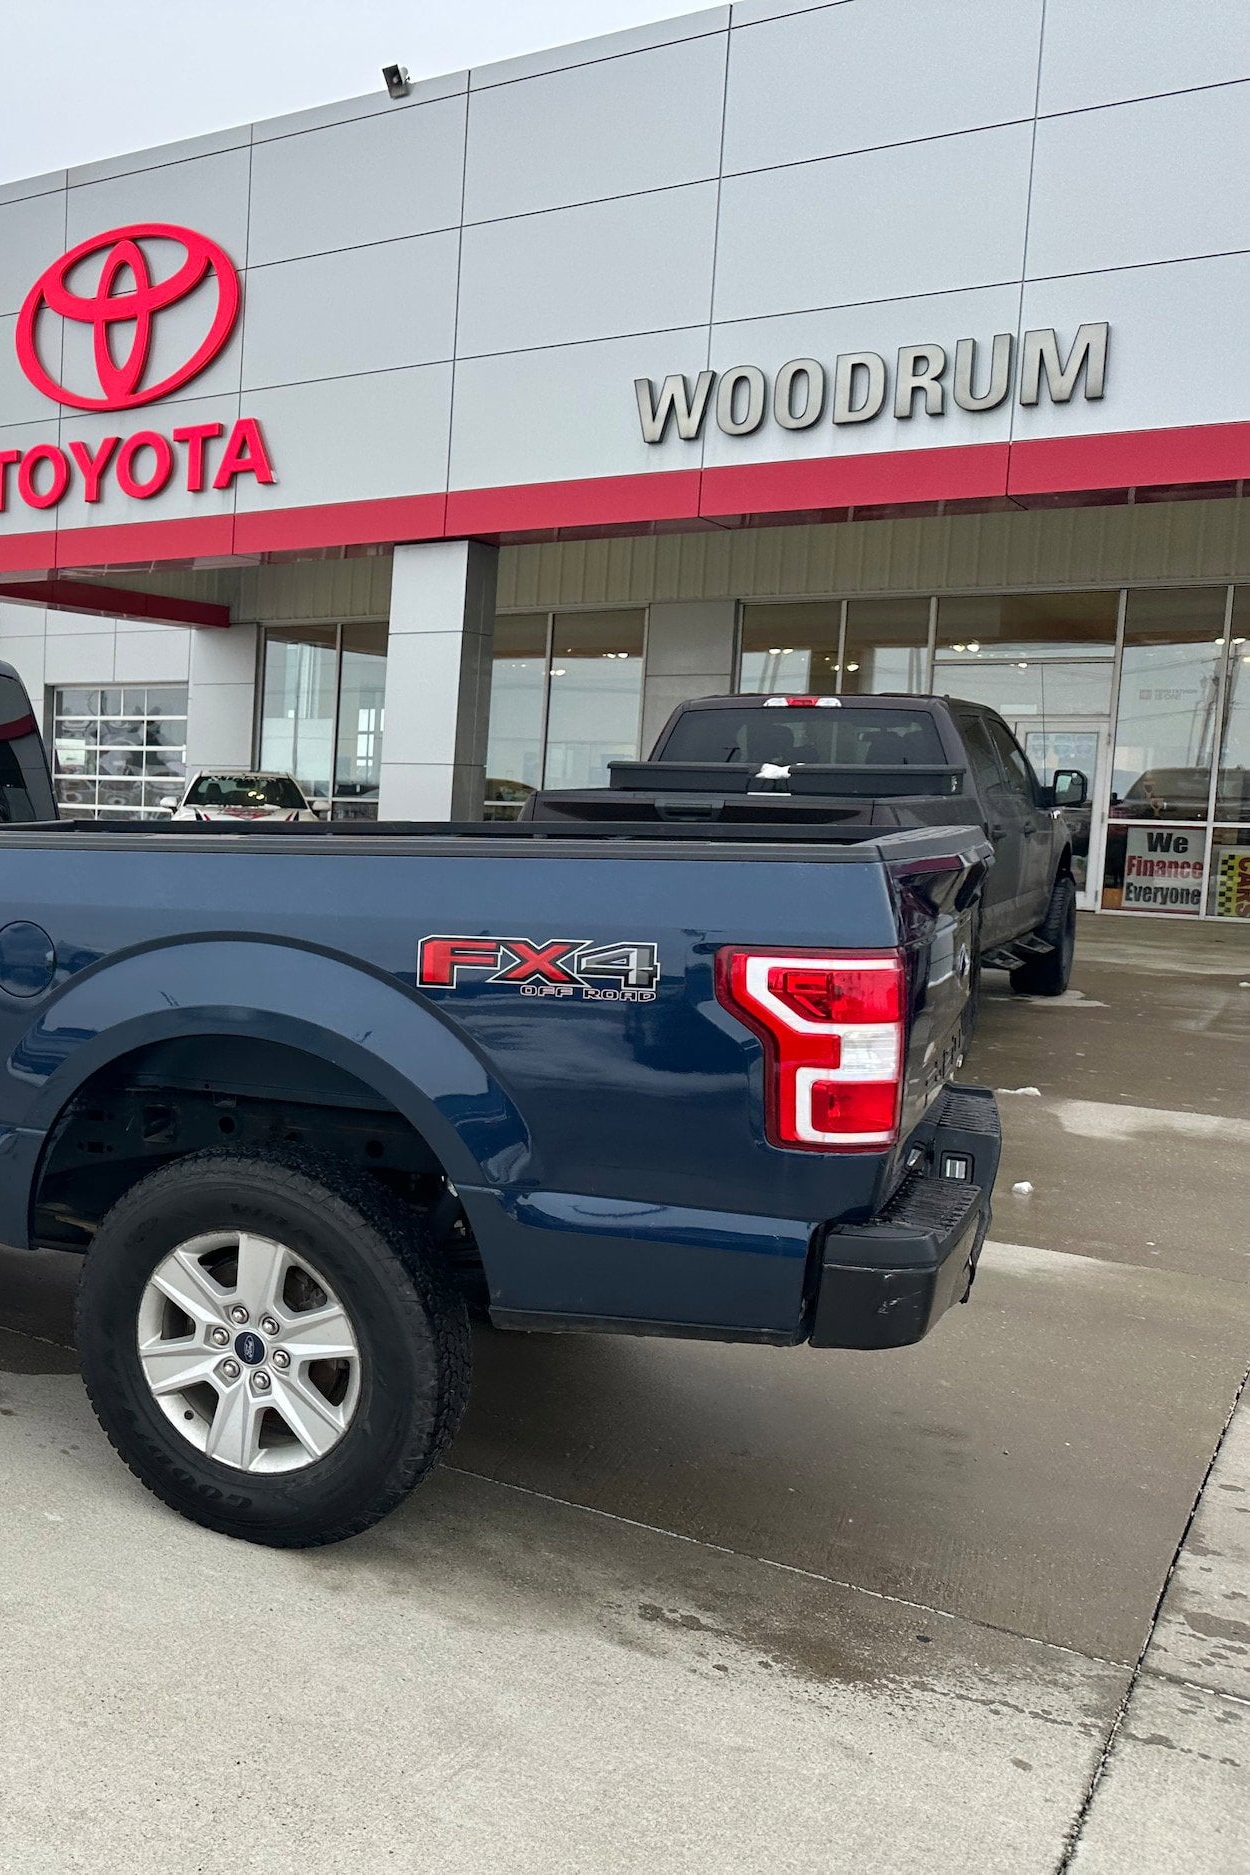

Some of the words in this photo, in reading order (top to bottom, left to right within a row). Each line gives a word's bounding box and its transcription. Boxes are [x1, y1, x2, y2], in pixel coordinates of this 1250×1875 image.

[634, 321, 1110, 444] WOODRUM
[1147, 832, 1189, 854] We
[1126, 855, 1203, 879] Finance
[1124, 881, 1201, 905] Everyone
[417, 934, 660, 990] FX4
[520, 984, 574, 998] OFF
[582, 987, 657, 1003] ROAD
